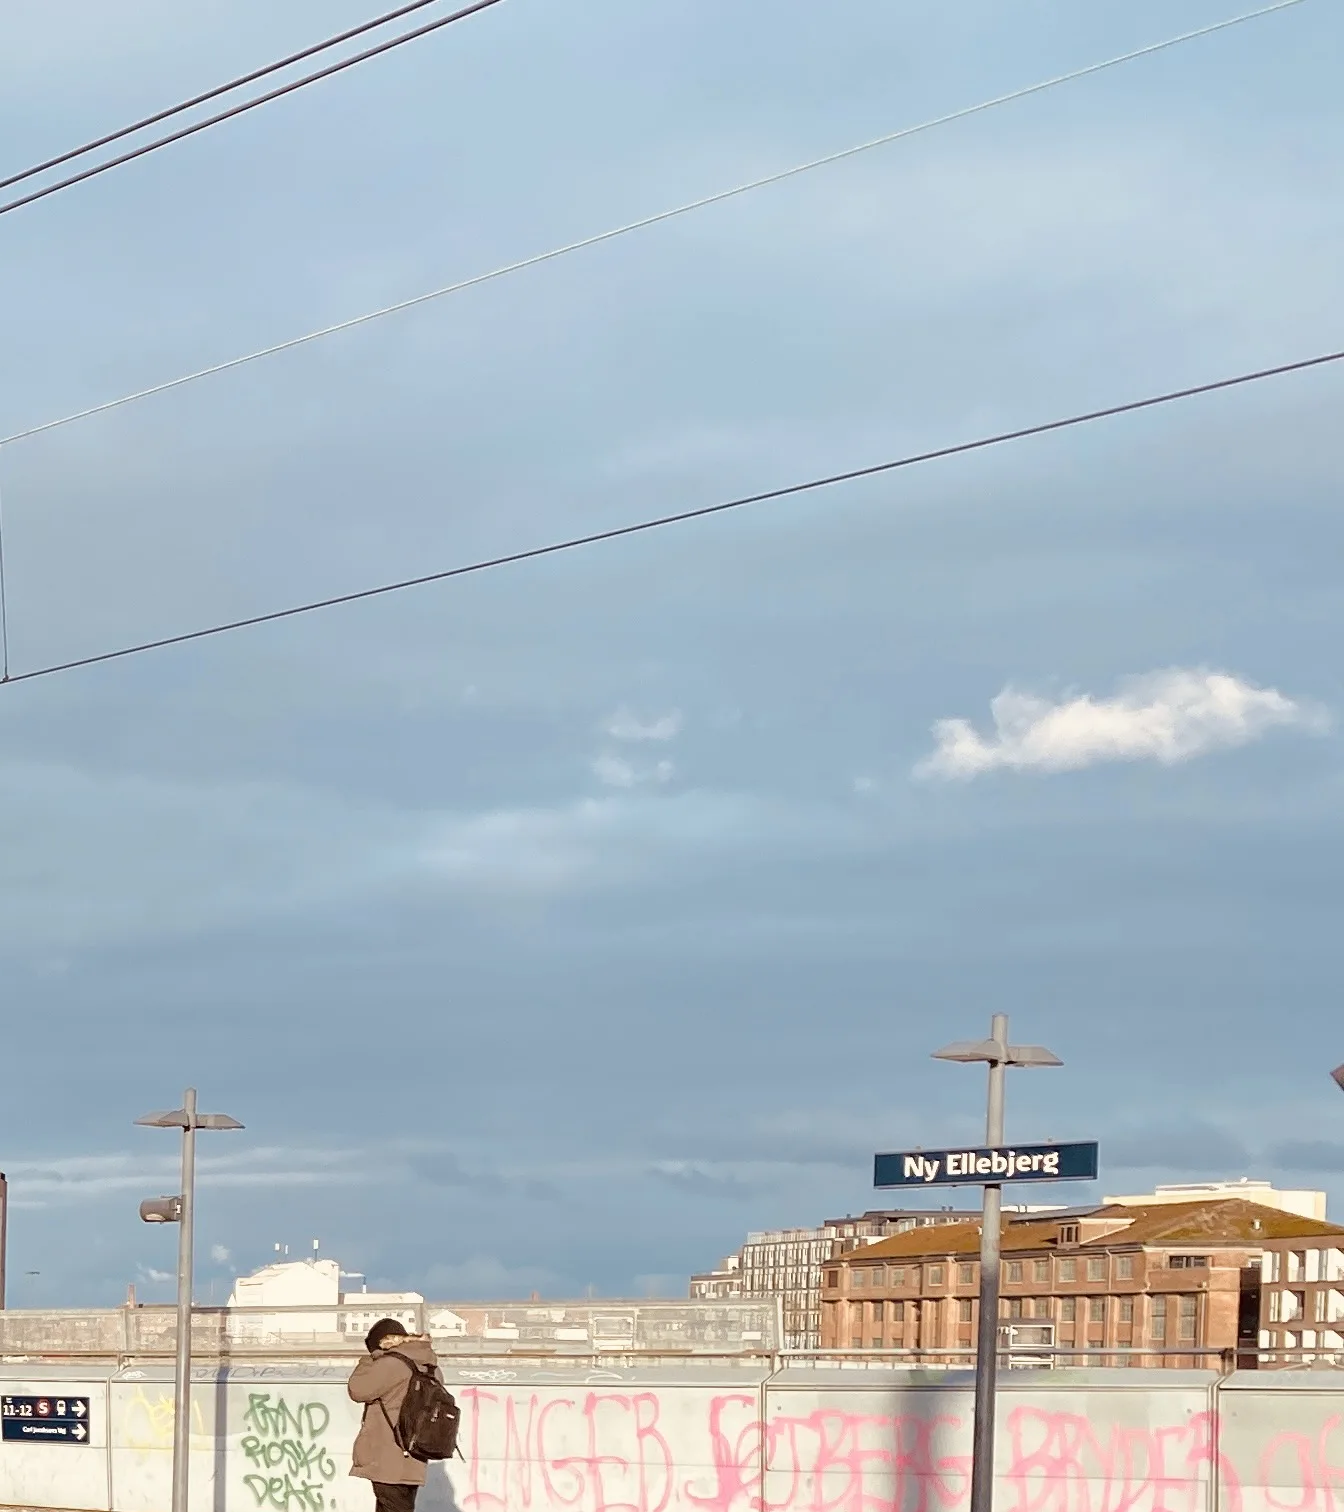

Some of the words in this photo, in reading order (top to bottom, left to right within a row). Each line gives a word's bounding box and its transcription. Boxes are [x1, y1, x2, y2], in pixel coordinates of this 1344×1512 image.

[904, 1156, 939, 1181] Ny
[946, 1150, 1059, 1178] Ellebjerg
[3, 1404, 33, 1417] 11-12
[38, 1402, 49, 1415] S
